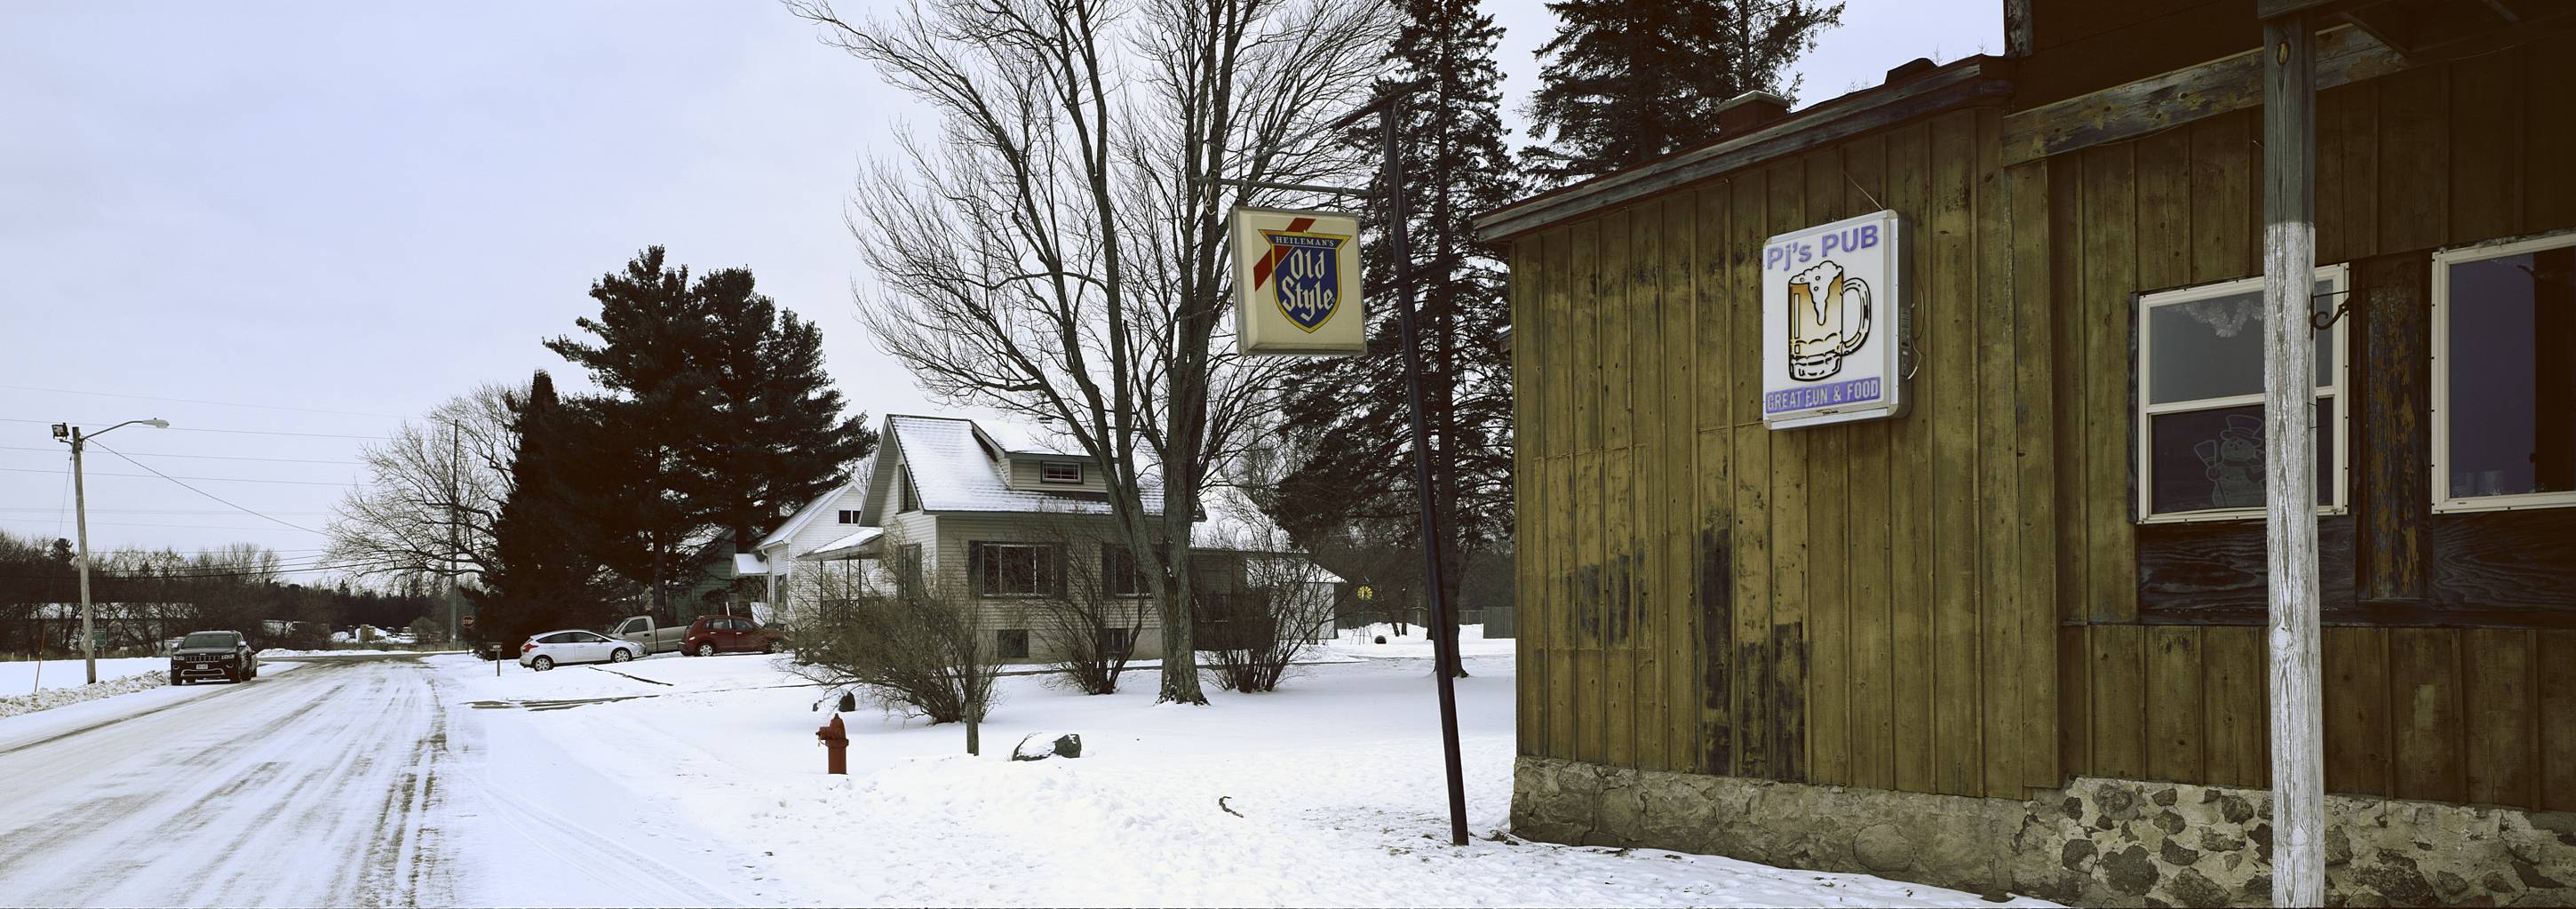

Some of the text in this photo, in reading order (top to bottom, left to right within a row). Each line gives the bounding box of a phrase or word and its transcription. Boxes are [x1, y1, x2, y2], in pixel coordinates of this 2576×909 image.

[1276, 236, 1334, 246] HEILEMAN'S
[1767, 225, 1878, 271] Pj's PUB
[1290, 249, 1324, 280] Old
[1282, 275, 1333, 322] Style
[1768, 379, 1879, 409] GREAT FUN & FOOD
